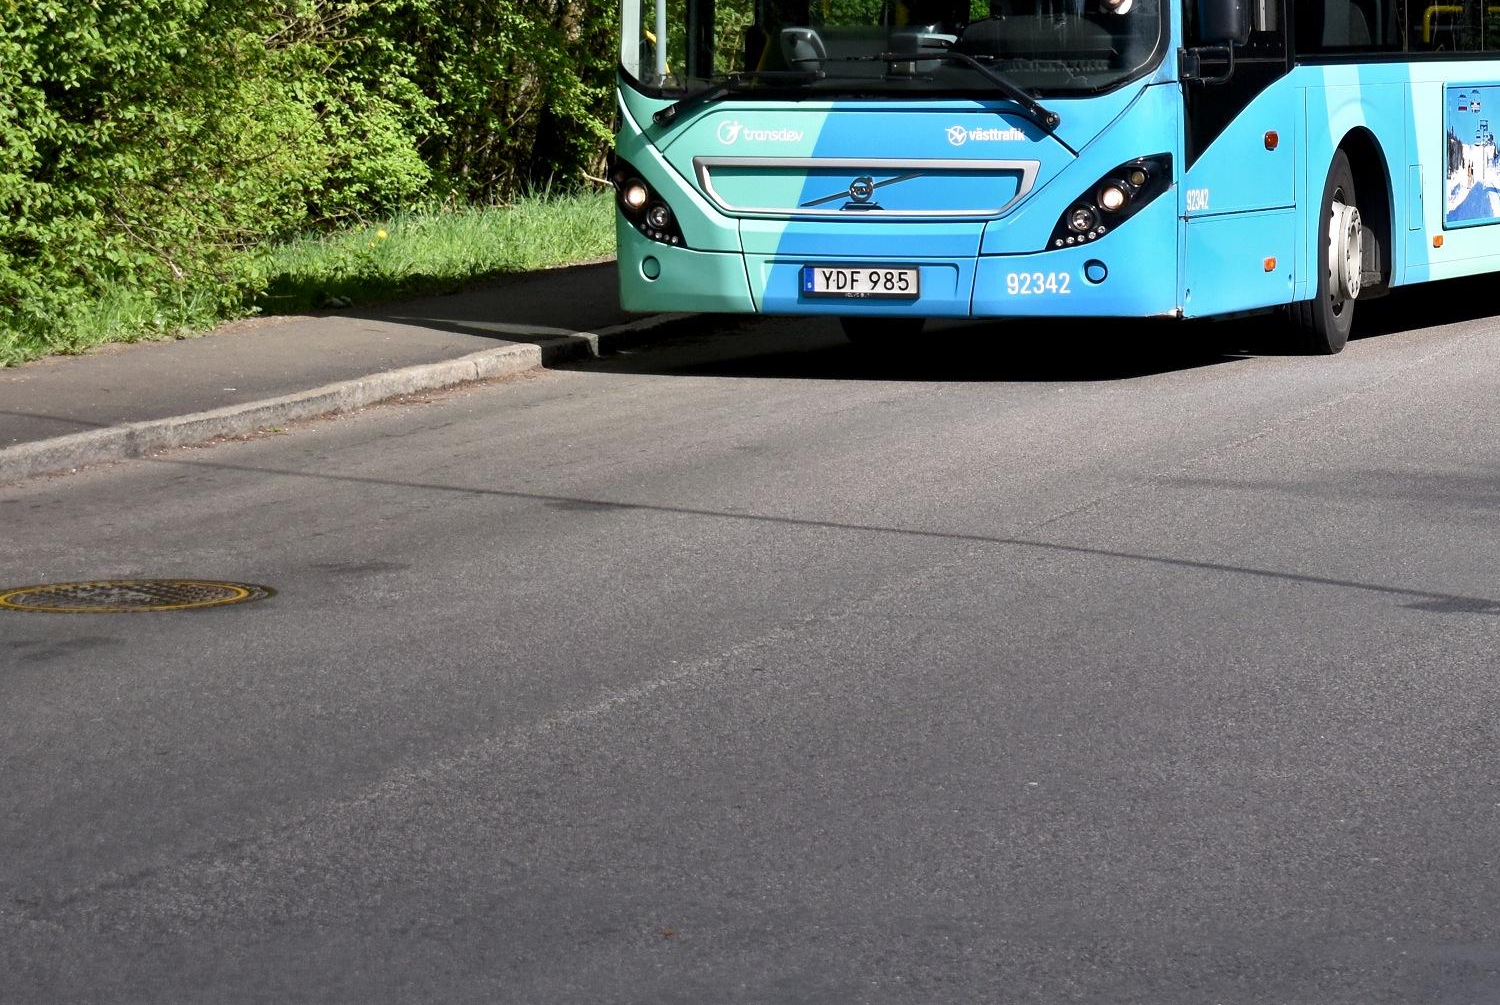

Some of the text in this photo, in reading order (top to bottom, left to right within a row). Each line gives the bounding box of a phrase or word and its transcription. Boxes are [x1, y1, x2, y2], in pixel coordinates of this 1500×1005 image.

[743, 127, 804, 143] transdev
[968, 127, 1026, 142] västtrafik
[1186, 188, 1209, 212] 92342
[822, 270, 910, 291] YDF 985
[1006, 272, 1071, 296] 92342
